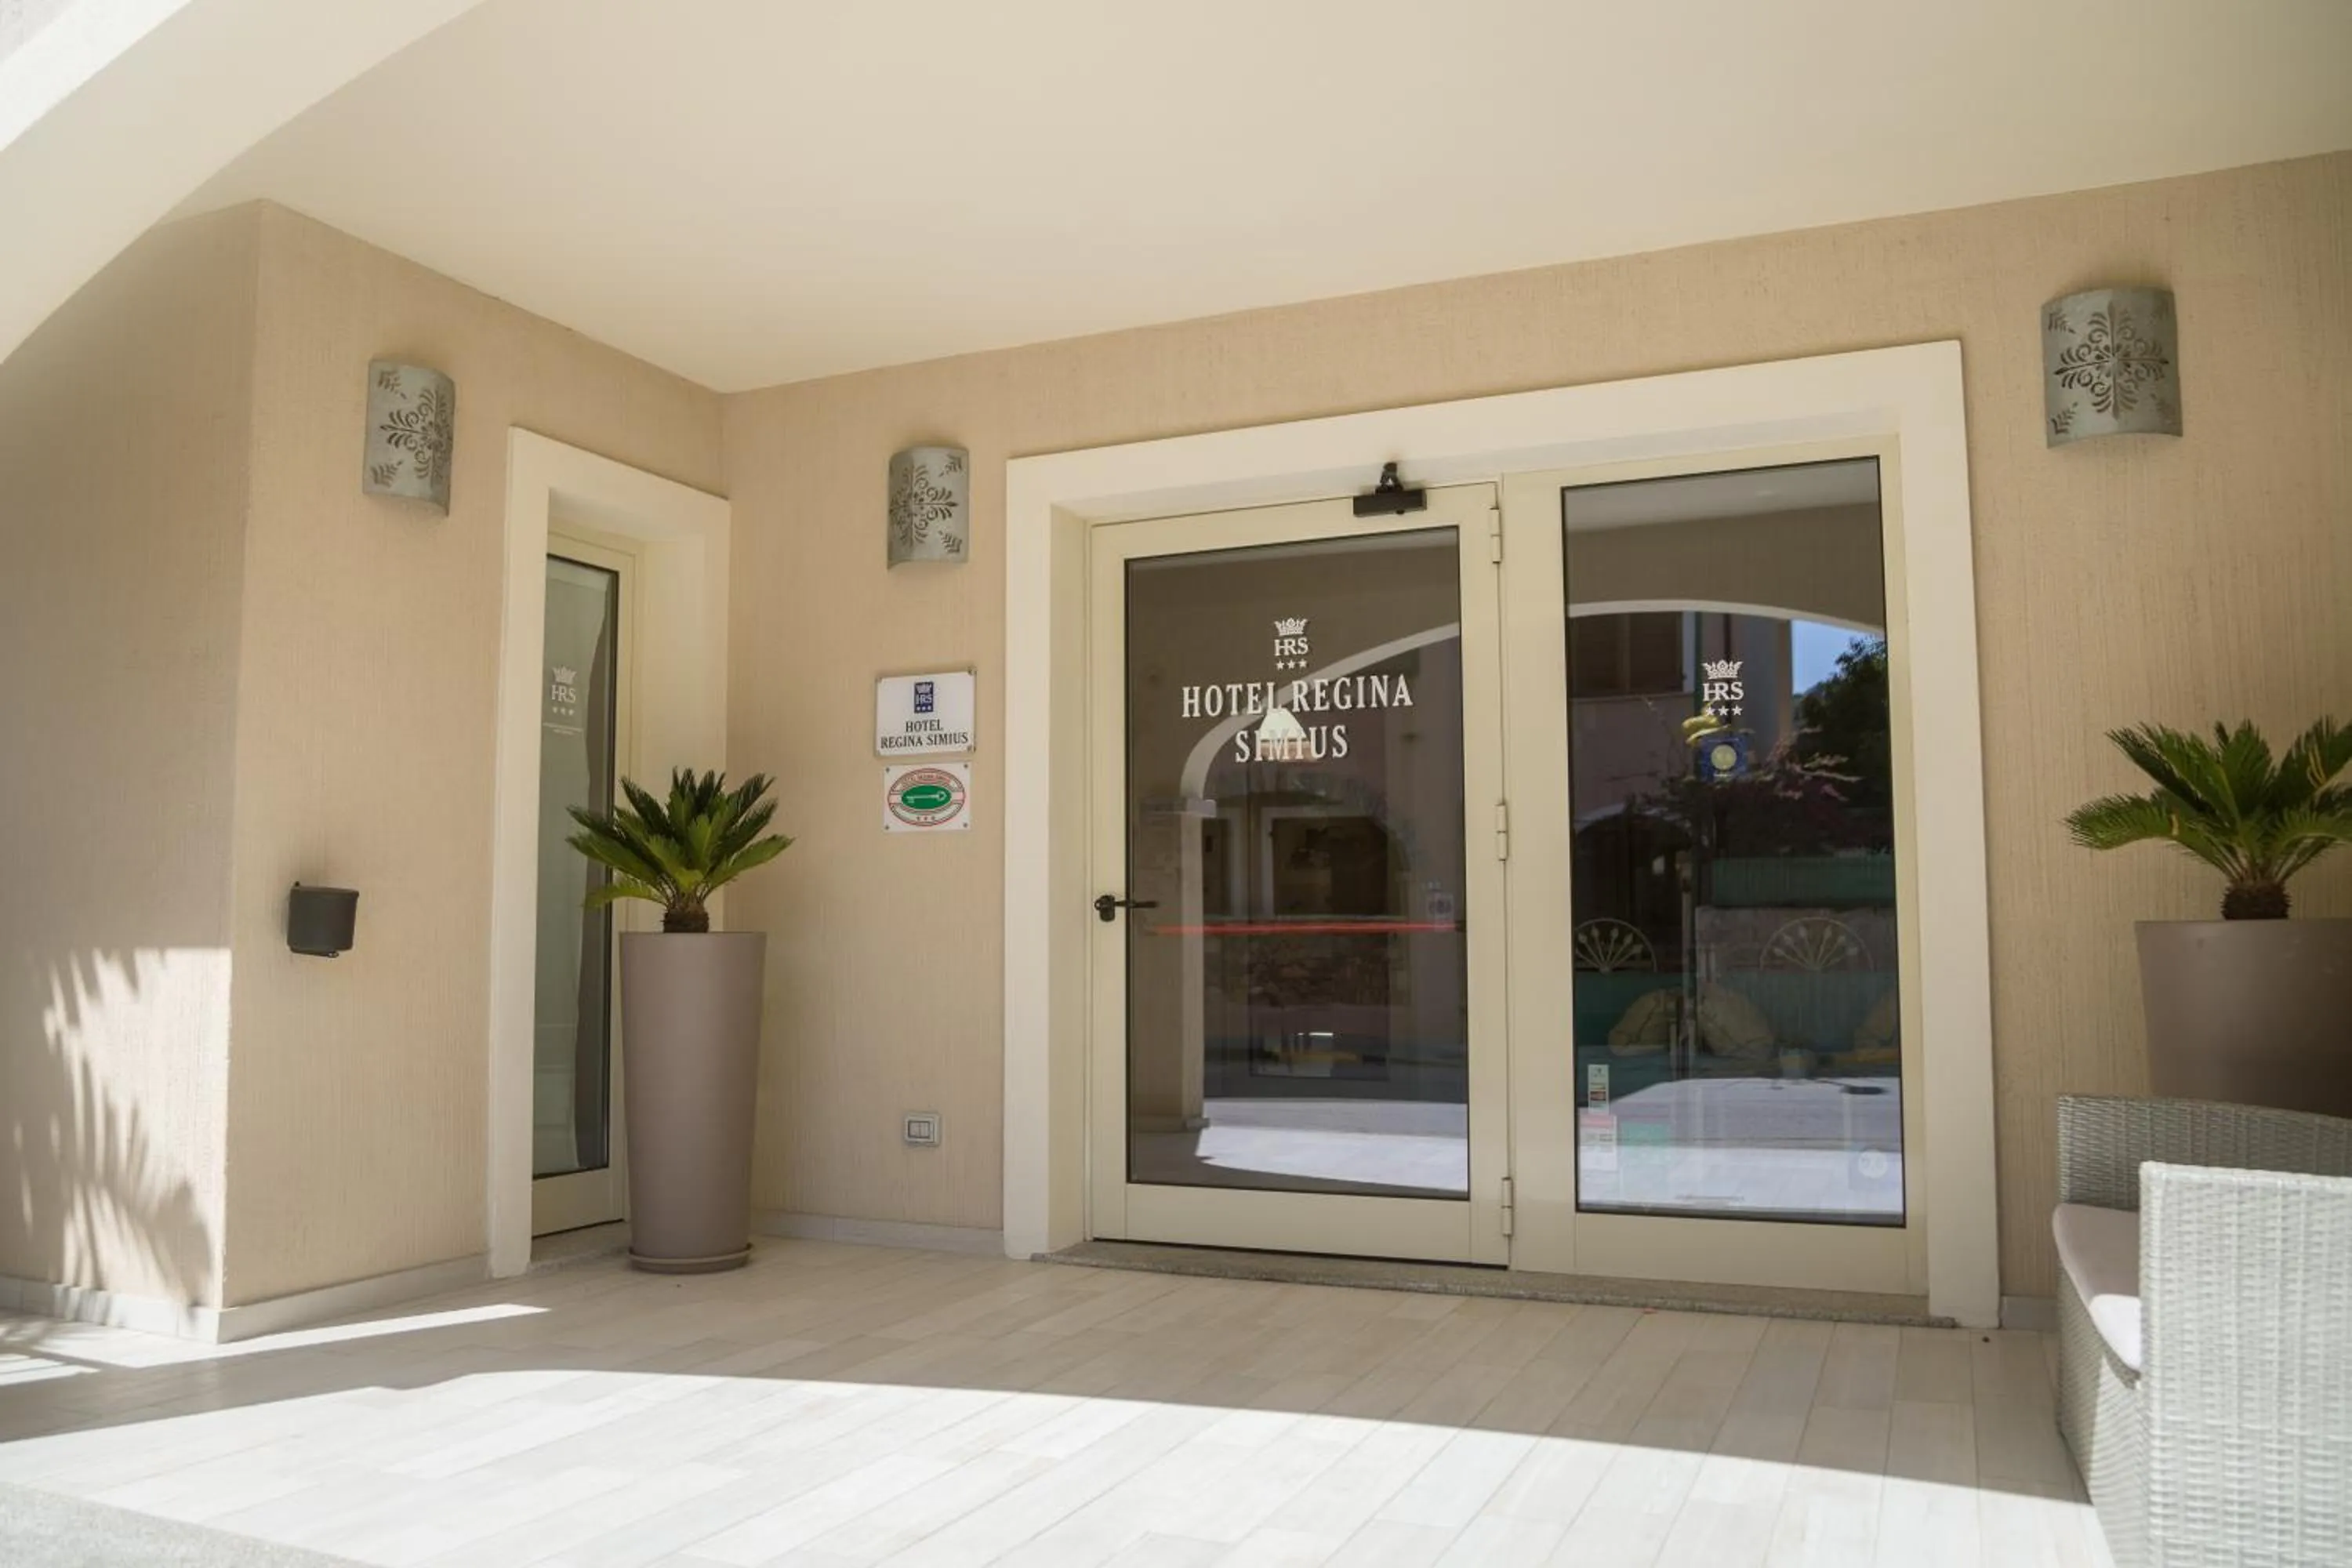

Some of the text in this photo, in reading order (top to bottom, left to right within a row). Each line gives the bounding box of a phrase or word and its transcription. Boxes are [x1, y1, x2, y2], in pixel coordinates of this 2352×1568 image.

[1274, 637, 1308, 656] HRS
[551, 684, 576, 703] HRS
[1182, 673, 1414, 718] HOTEL REGINA
[1702, 681, 1744, 702] HRS
[906, 719, 943, 732] HOTEL
[880, 731, 968, 749] REGINA SIMIUS
[1235, 724, 1348, 763] SIMIUS
